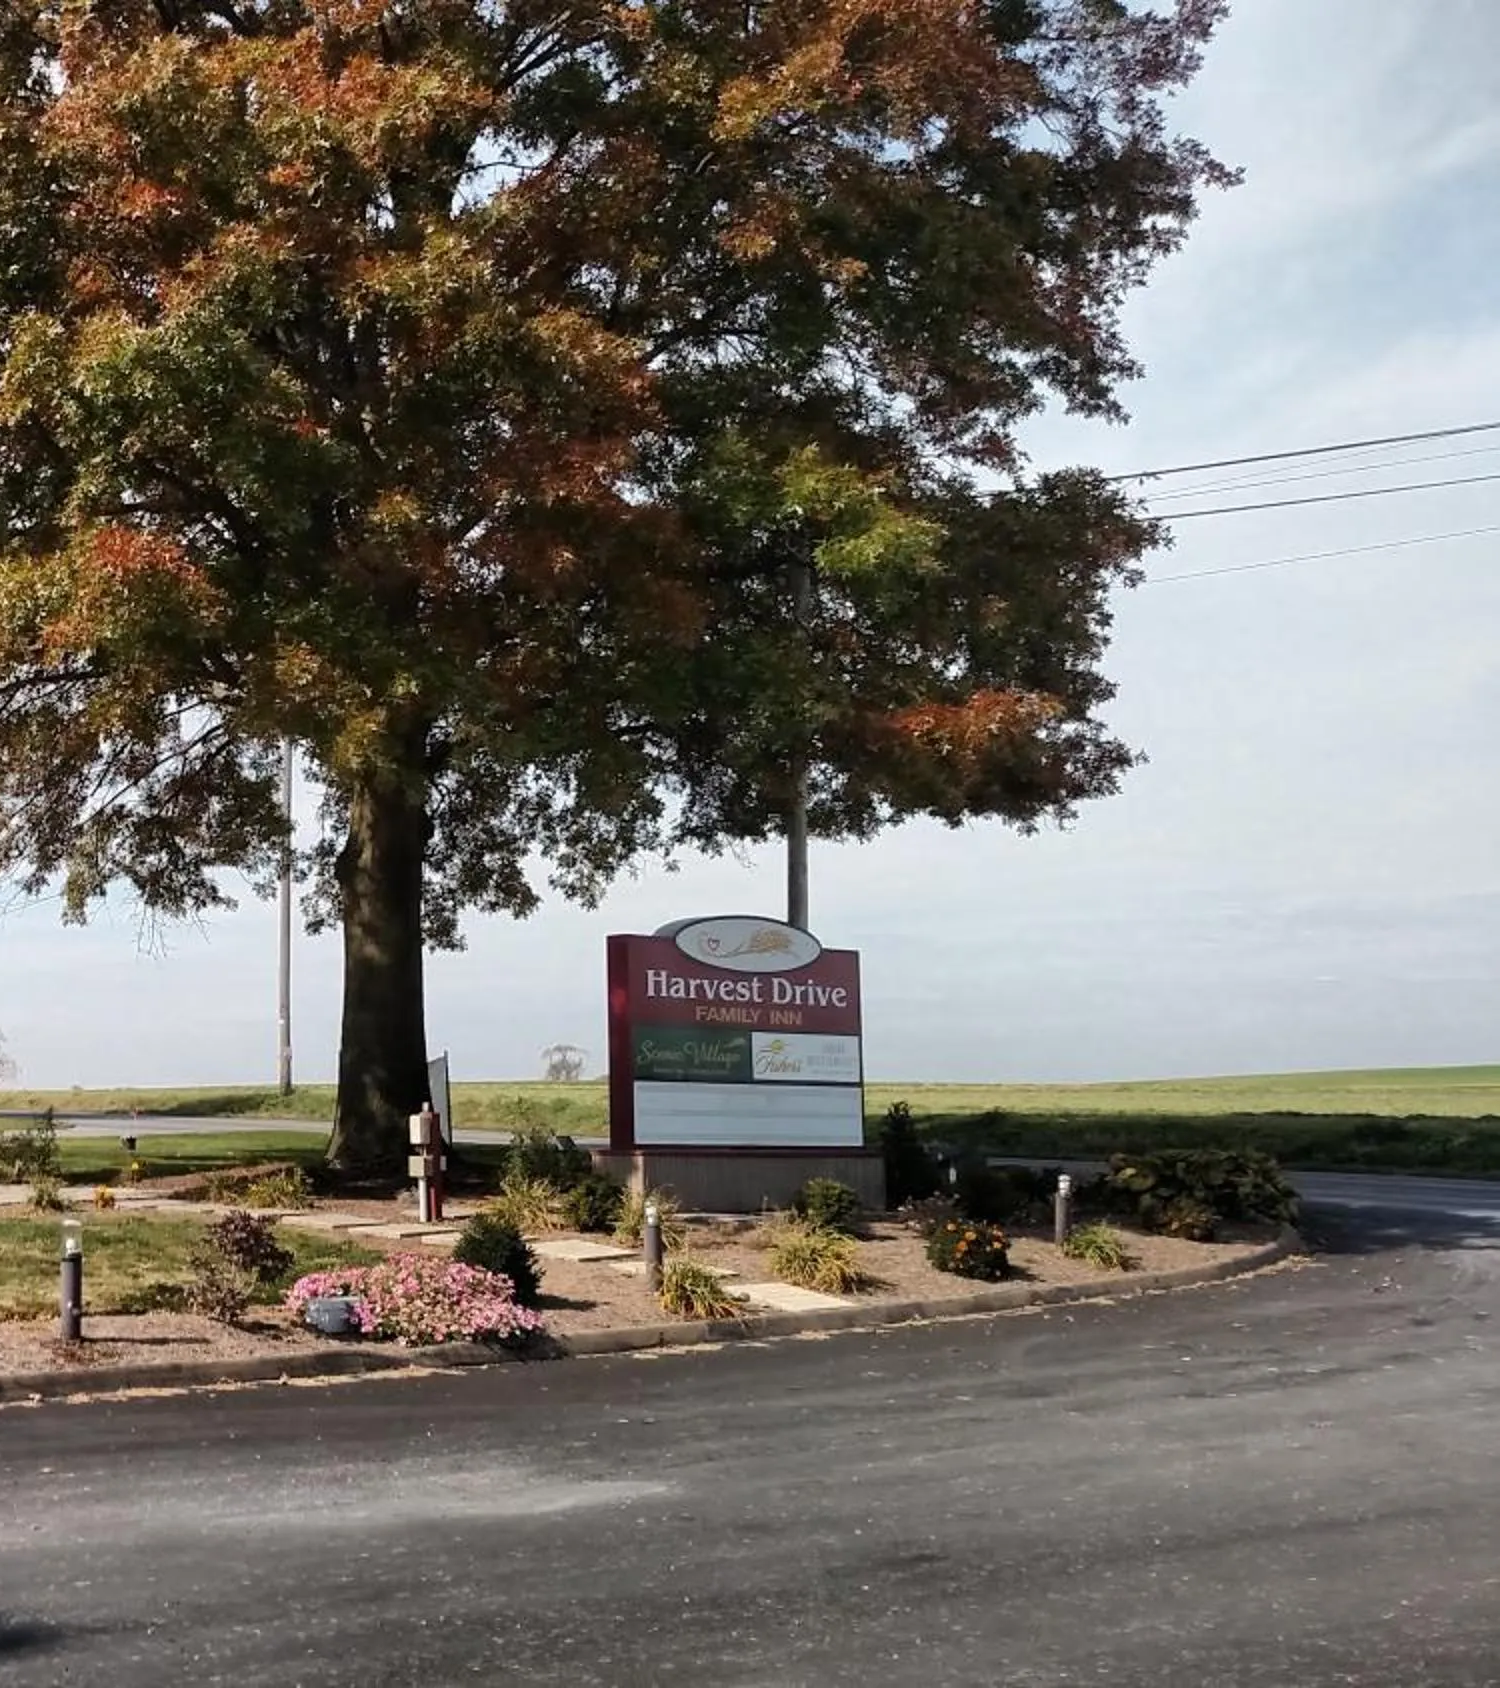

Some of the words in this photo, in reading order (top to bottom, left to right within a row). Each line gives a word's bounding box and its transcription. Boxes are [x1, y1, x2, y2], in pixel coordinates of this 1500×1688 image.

[646, 969, 763, 1003] Harvest
[771, 976, 848, 1008] Drive
[695, 1005, 761, 1025] FAMILY
[769, 1008, 803, 1025] INN
[682, 1039, 741, 1069] Village
